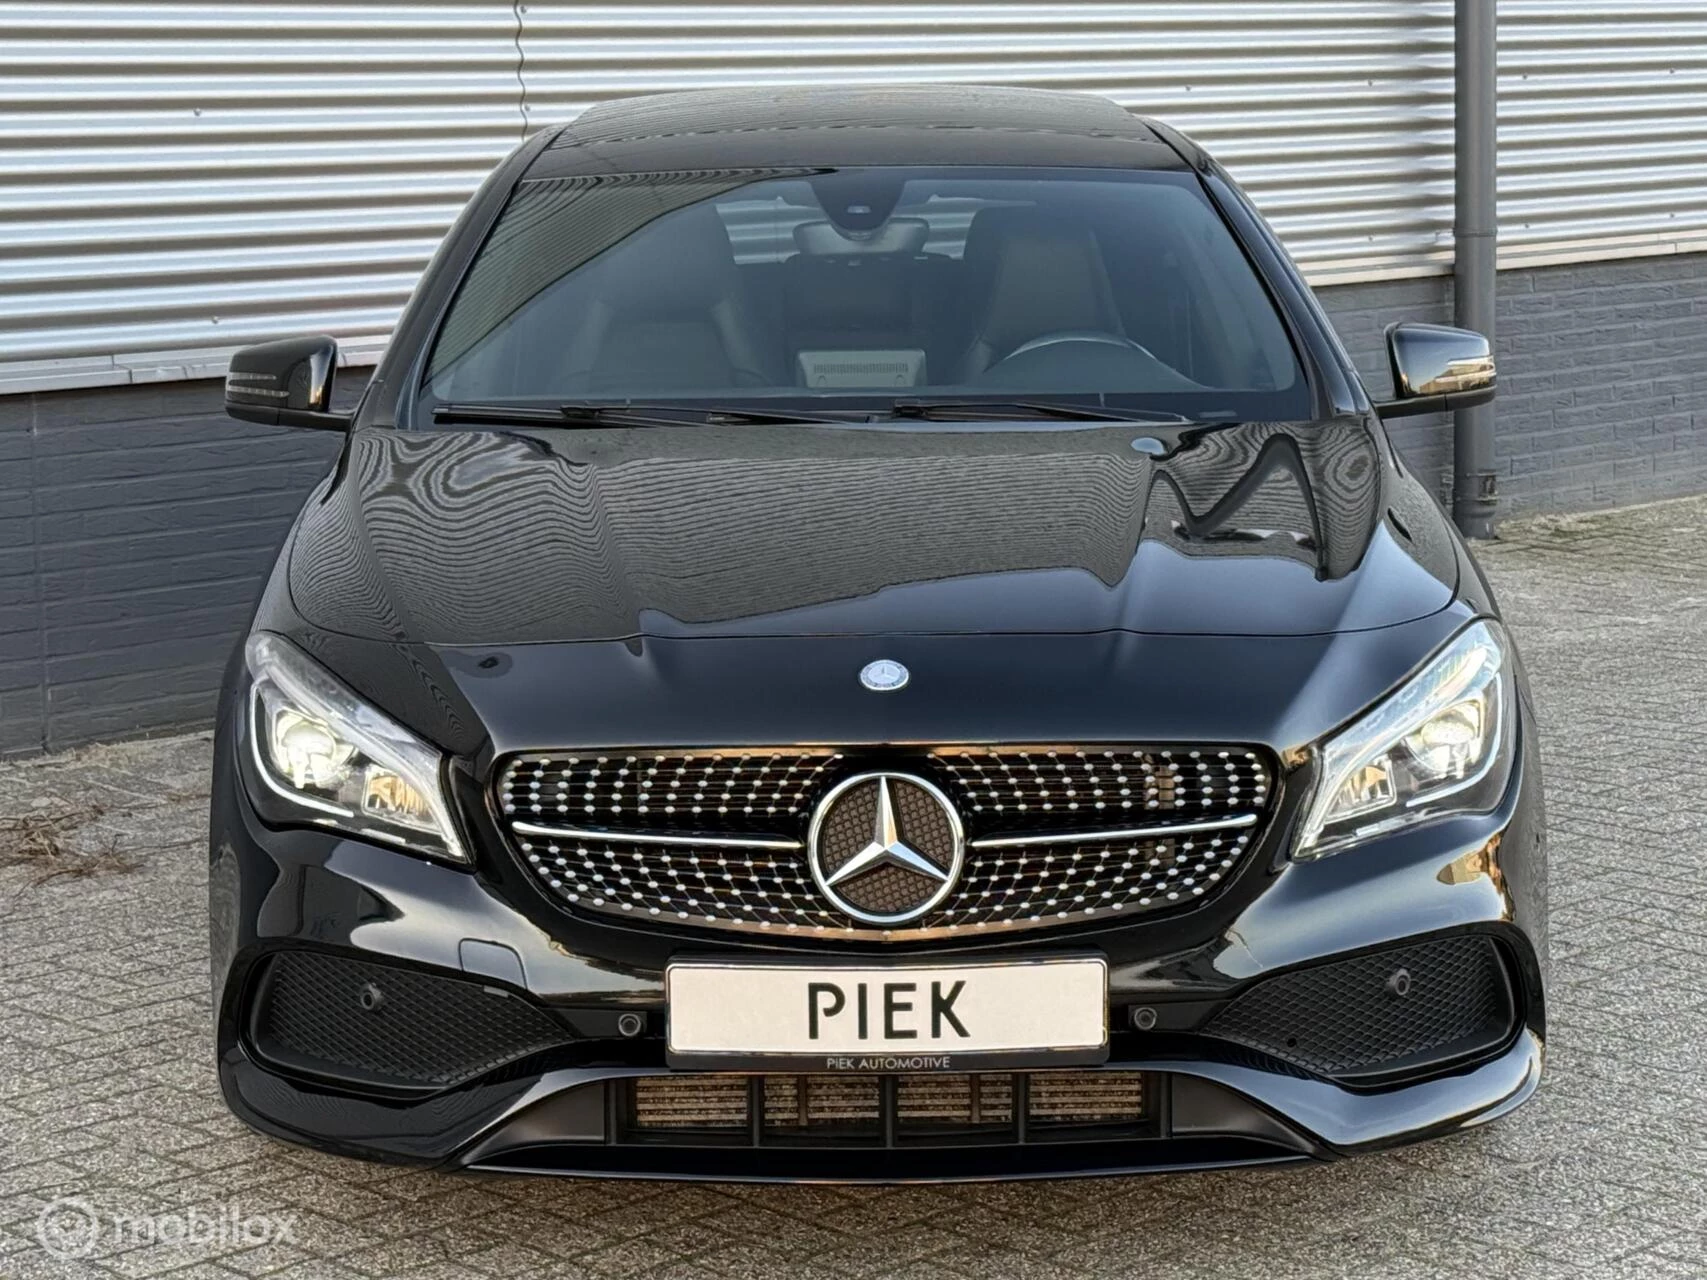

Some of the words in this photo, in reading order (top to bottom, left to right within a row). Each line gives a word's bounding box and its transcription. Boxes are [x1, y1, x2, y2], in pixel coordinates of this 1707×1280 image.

[808, 980, 970, 1040] PIEK
[826, 1057, 855, 1070] PIEK
[858, 1056, 951, 1070] AUTOMOTIVE
